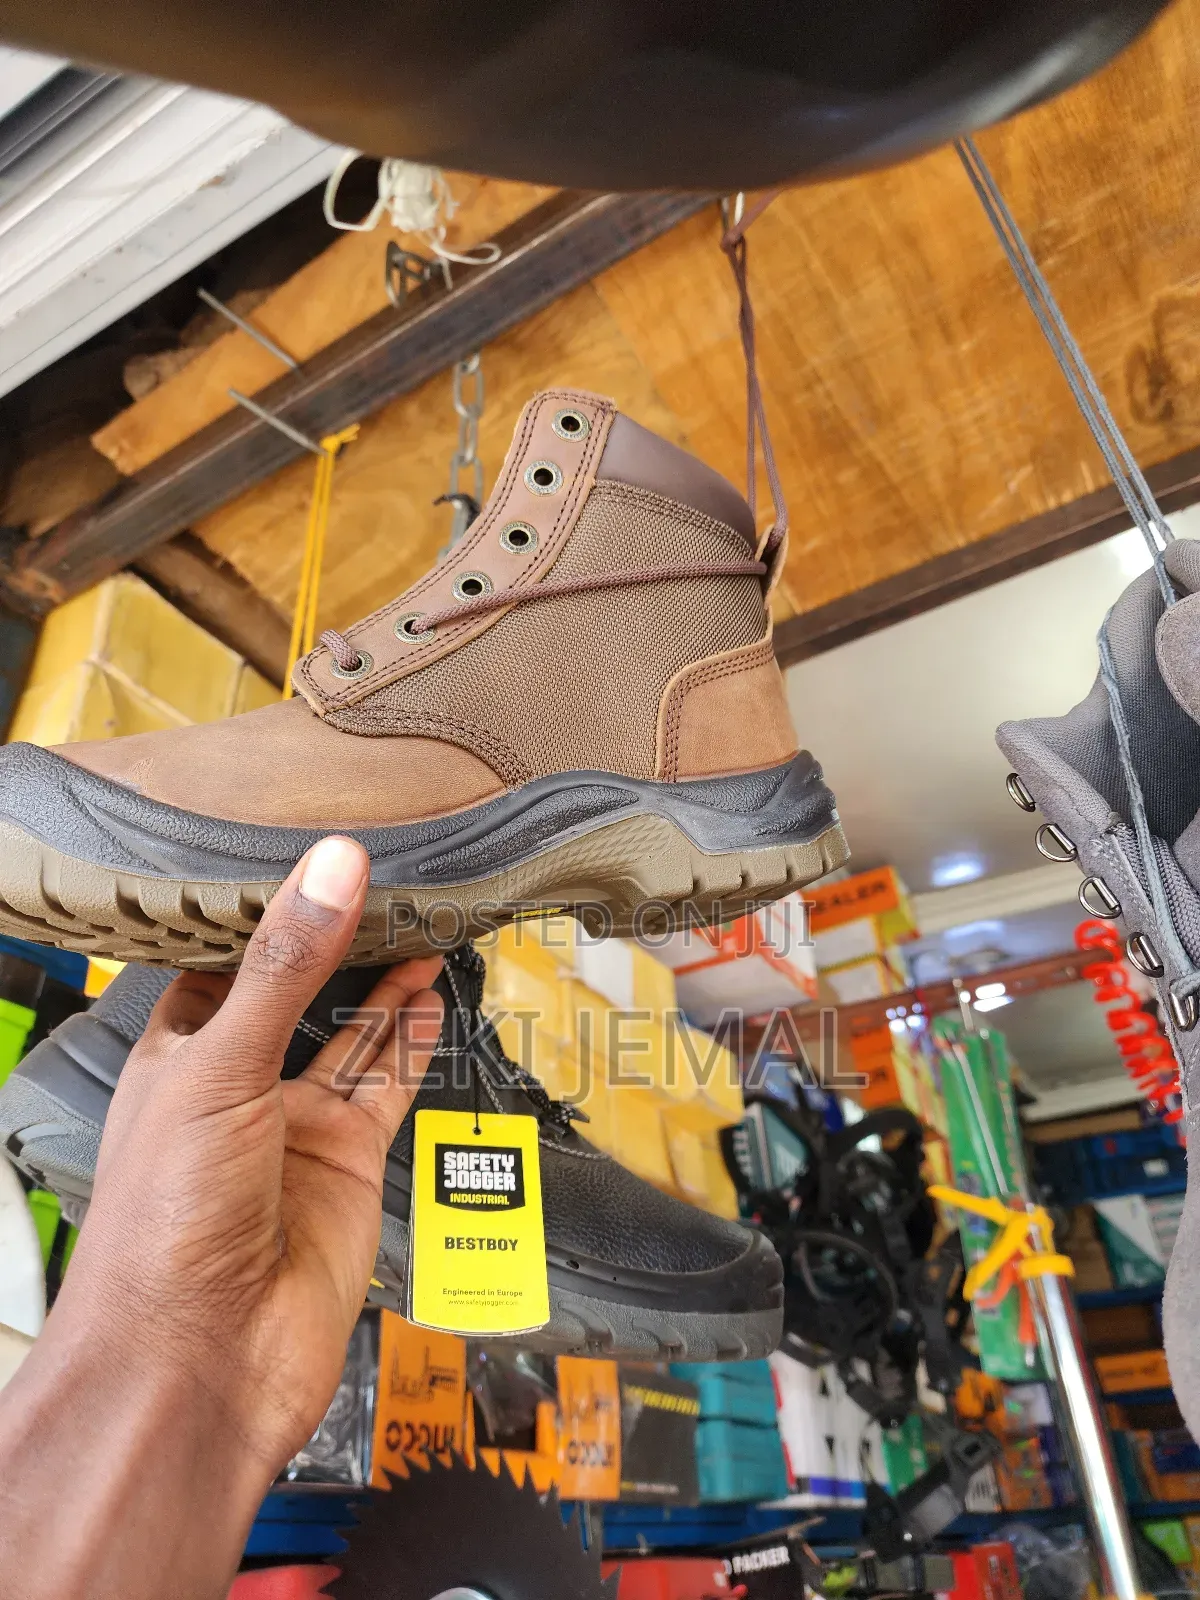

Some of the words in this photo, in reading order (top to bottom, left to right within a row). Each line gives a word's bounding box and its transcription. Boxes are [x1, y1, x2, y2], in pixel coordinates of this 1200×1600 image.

[443, 1151, 515, 1173] SAFETY
[443, 1169, 516, 1192] JOGGER
[449, 1192, 510, 1206] INDUSTRIAL
[444, 1236, 519, 1252] BESTBOY
[442, 1287, 486, 1297] Engineered
[487, 1288, 495, 1296] in
[497, 1289, 523, 1298] Europe
